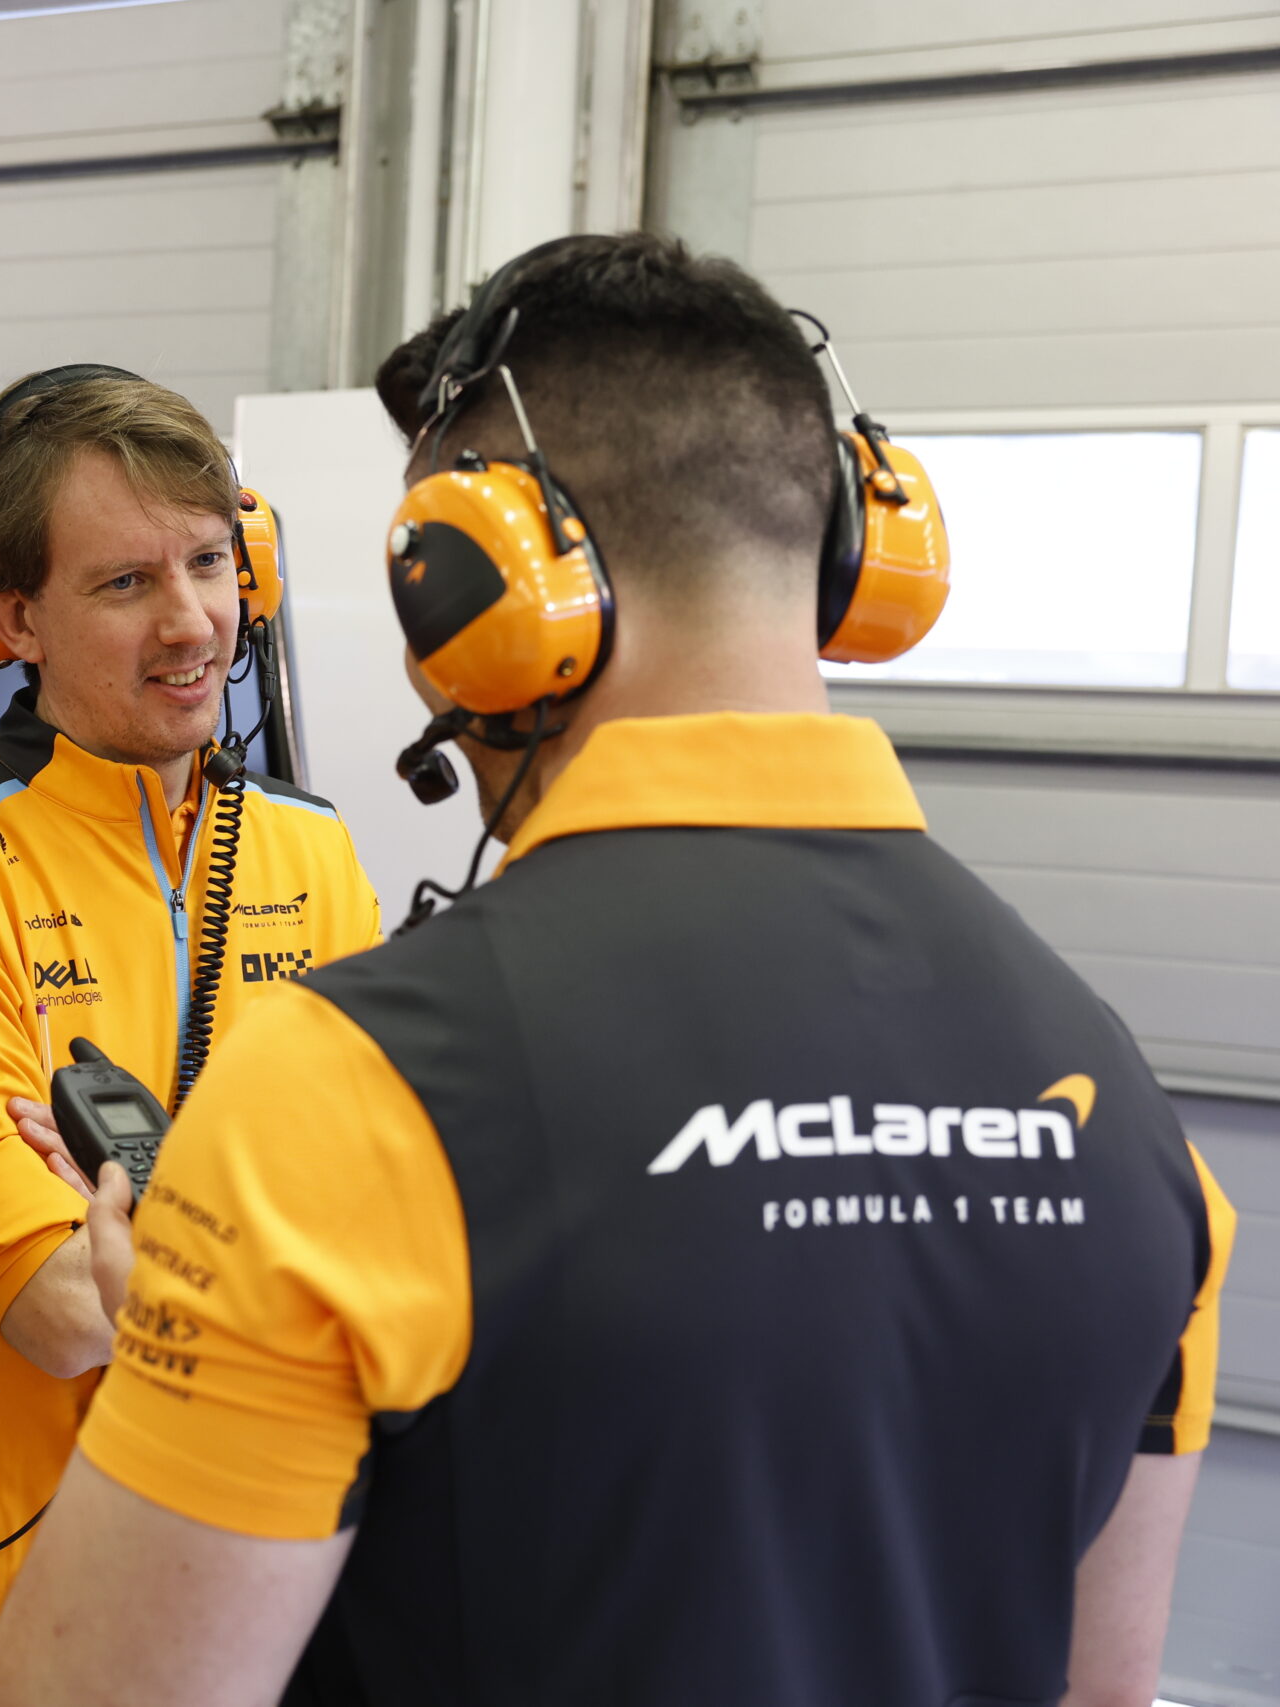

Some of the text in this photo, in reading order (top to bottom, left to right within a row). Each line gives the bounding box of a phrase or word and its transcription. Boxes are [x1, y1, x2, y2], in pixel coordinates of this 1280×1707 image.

[24, 910, 68, 930] ndroid
[231, 902, 300, 916] McLaren
[34, 958, 98, 990] DELL
[646, 1094, 1076, 1176] McLaren
[763, 1195, 1084, 1232] FORMULA 1 TEAM
